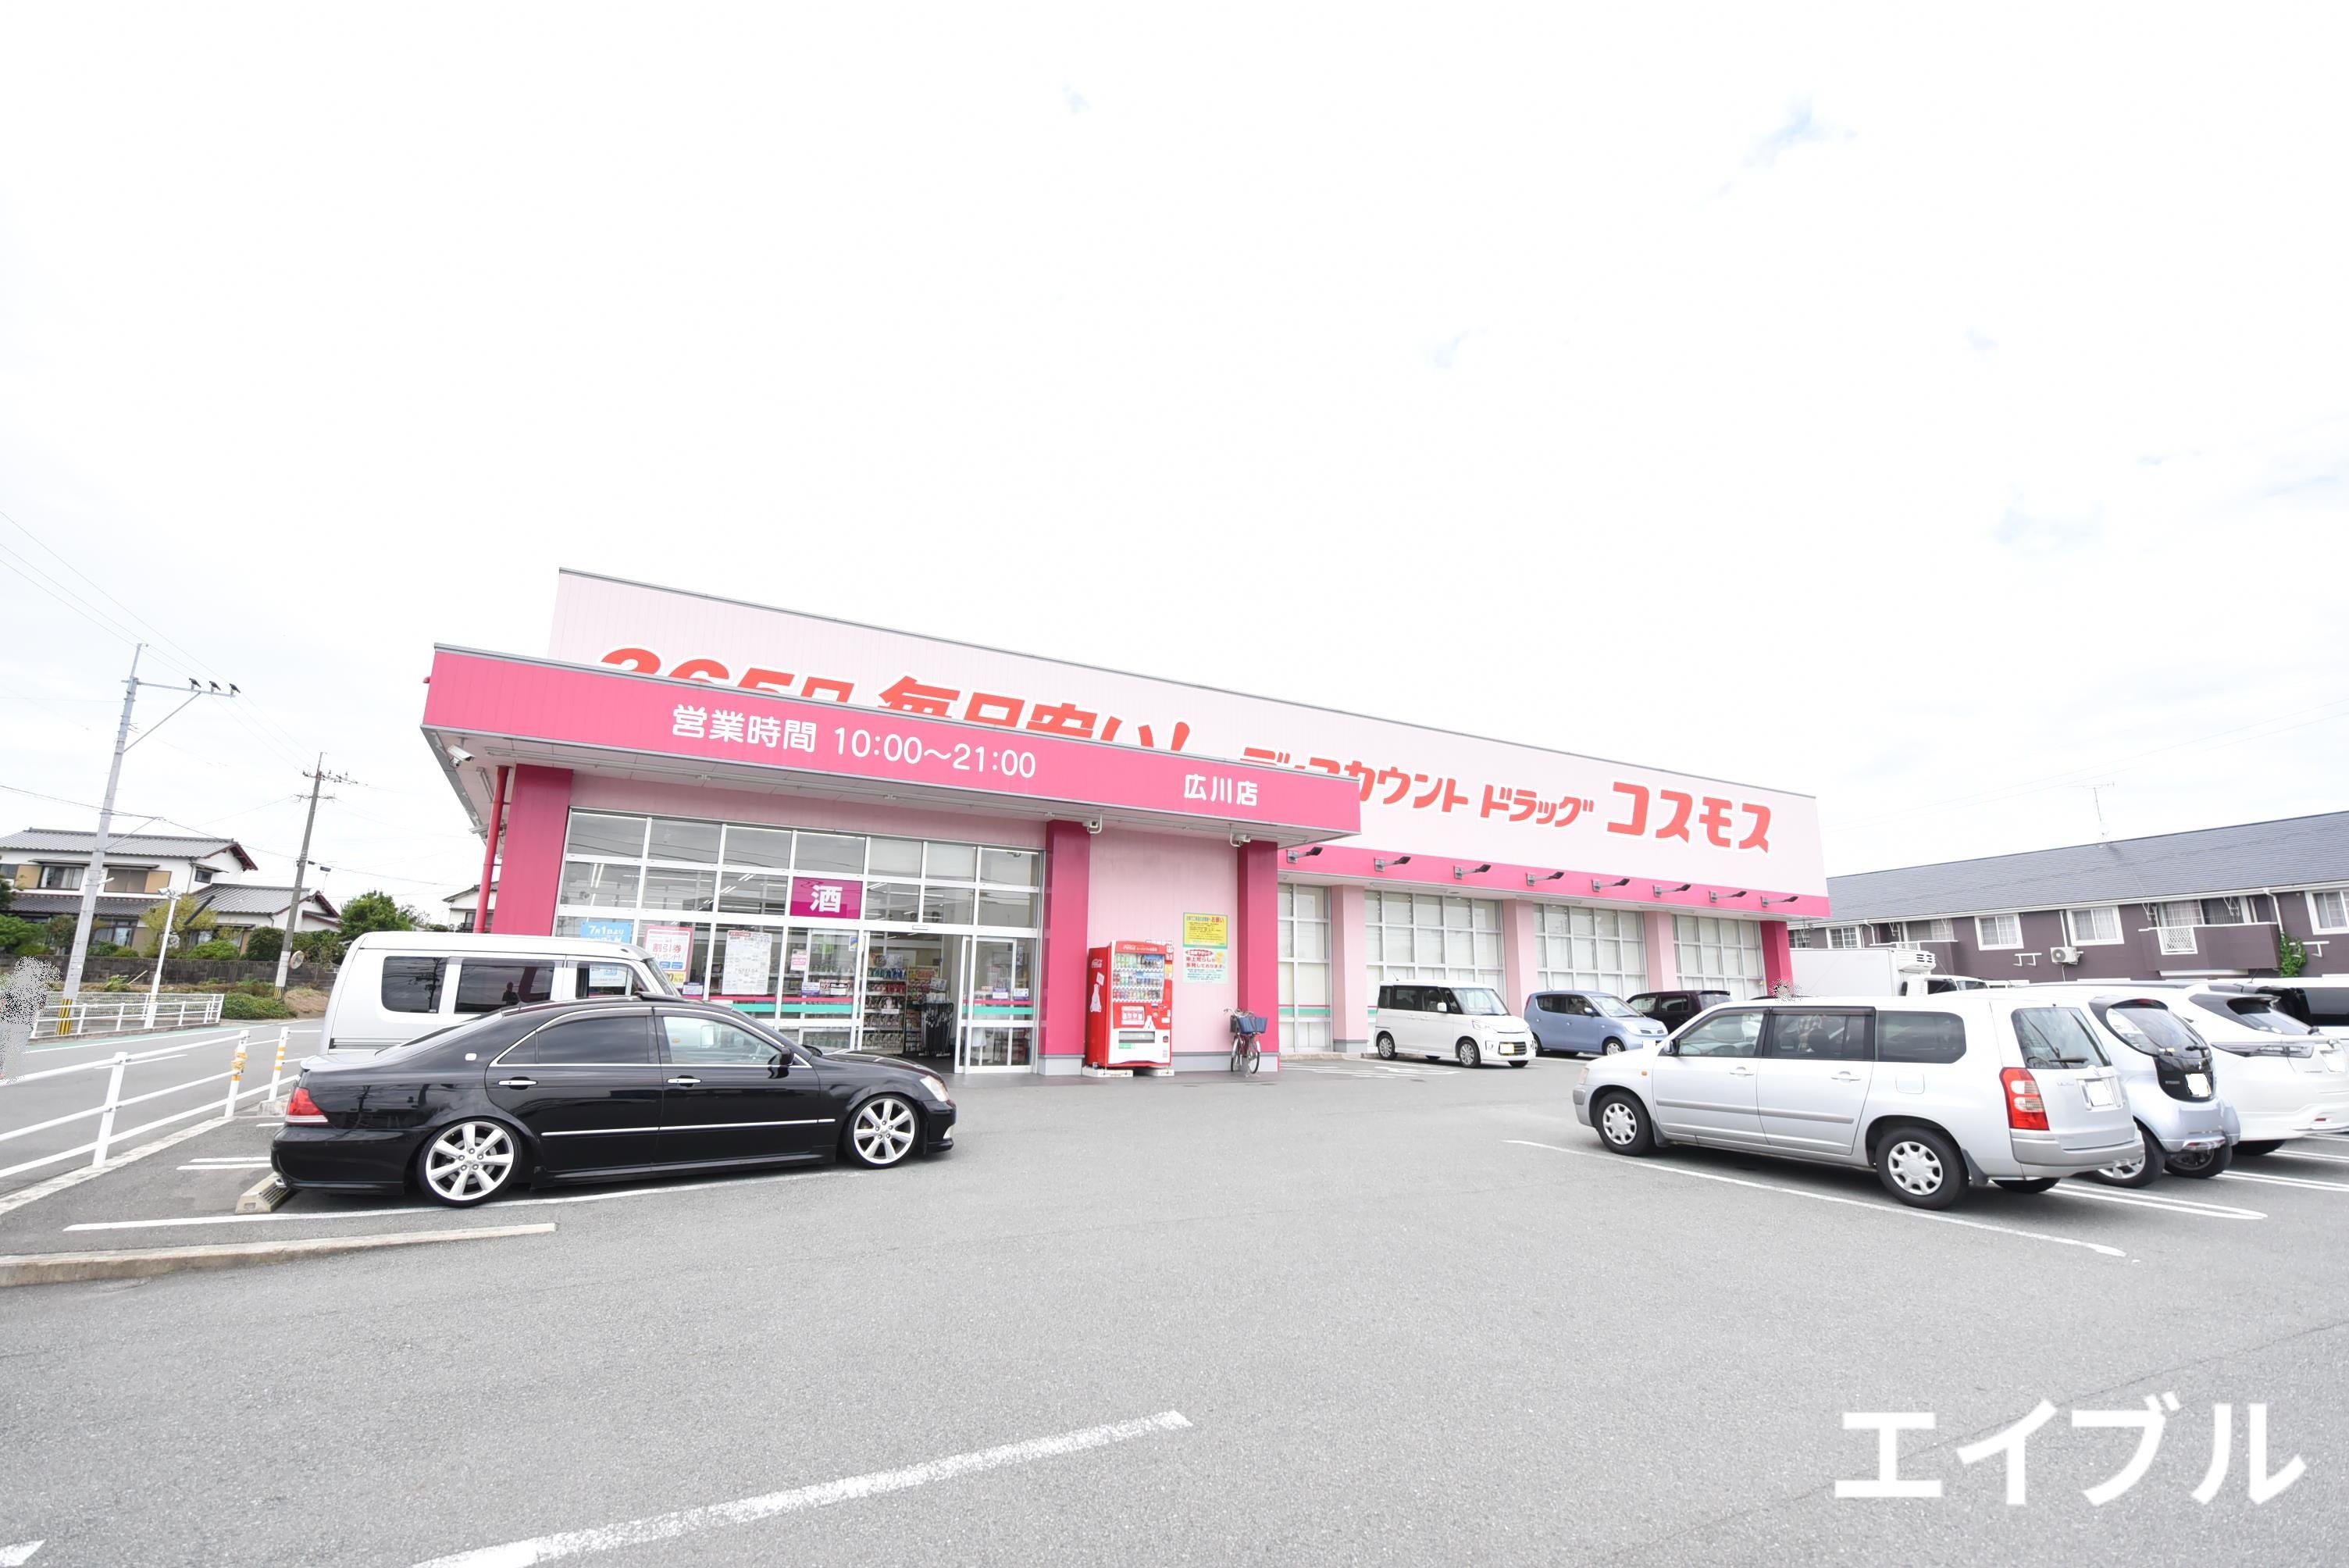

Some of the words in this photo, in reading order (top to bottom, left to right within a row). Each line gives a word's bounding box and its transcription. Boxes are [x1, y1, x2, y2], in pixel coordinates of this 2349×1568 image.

[672, 704, 818, 754] 営業時間
[1183, 773, 1259, 807] 広川店
[1480, 783, 1595, 828] ドラッグ
[1607, 782, 1773, 854] コスモス
[809, 883, 842, 914] 酒
[652, 943, 682, 953] 割引券
